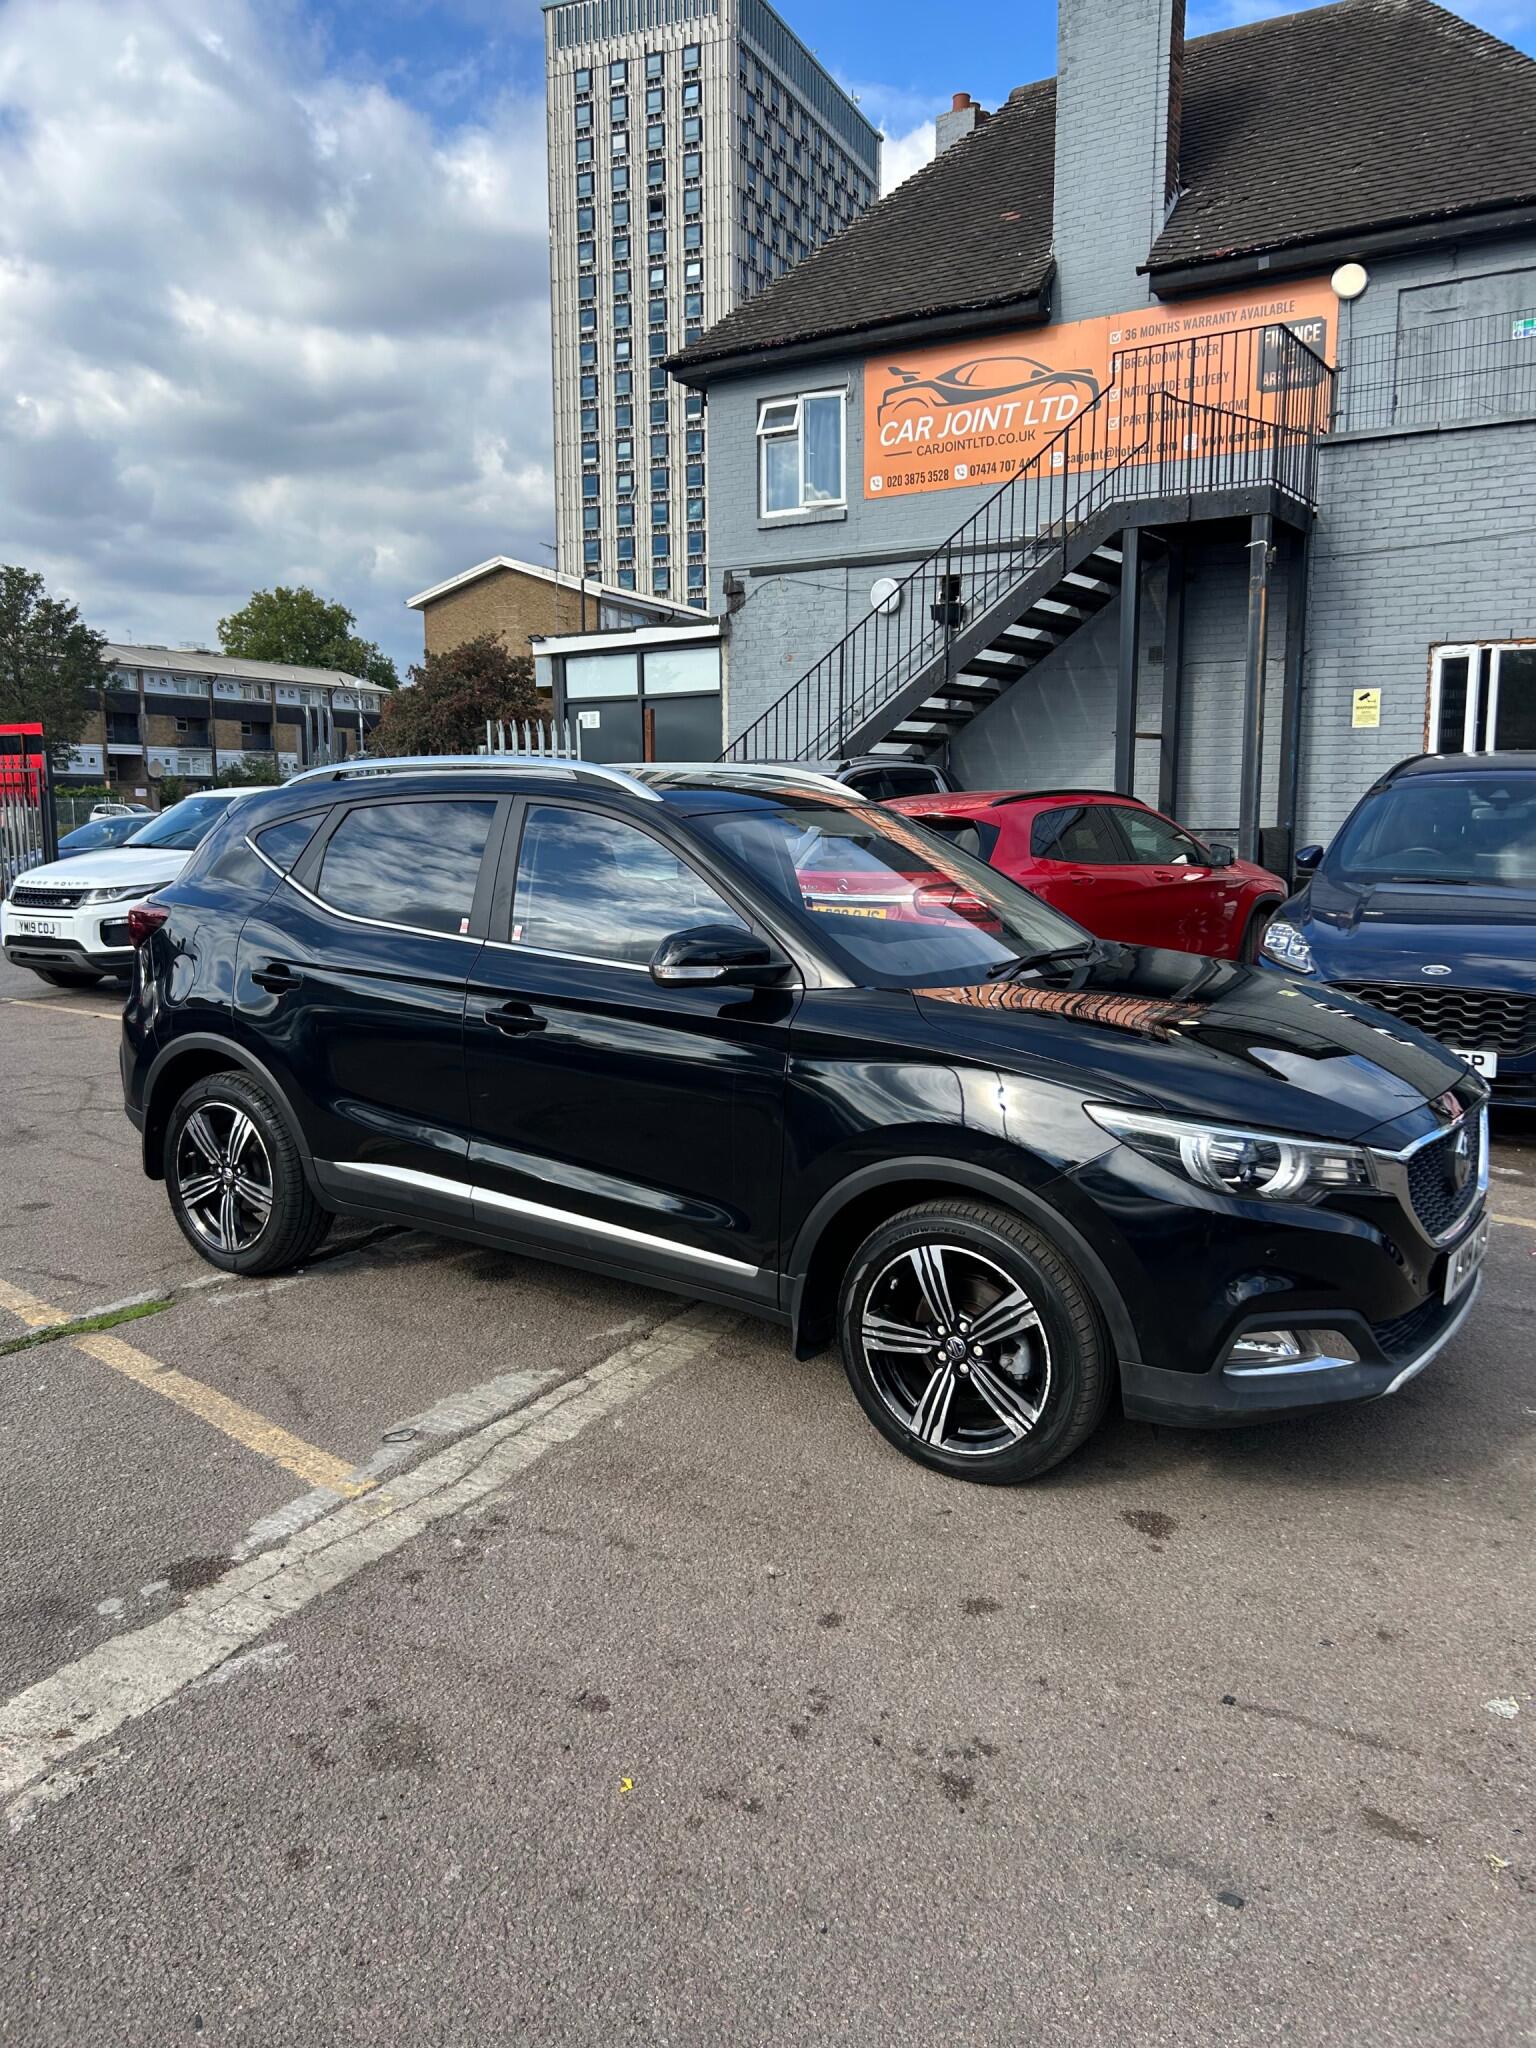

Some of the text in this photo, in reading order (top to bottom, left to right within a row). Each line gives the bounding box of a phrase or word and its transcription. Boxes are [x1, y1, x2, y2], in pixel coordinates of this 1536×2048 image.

[1125, 300, 1296, 341] 36 MONTHS WARRANTY AVAILABLE
[880, 394, 1079, 446] CAR JOINT LTD
[1123, 413, 1147, 427] PART
[916, 429, 1036, 457] CARJOINTLTD.CO.UK
[887, 469, 949, 488] 020 3875 3528
[970, 462, 997, 476] 07474
[1000, 459, 1016, 472] 707
